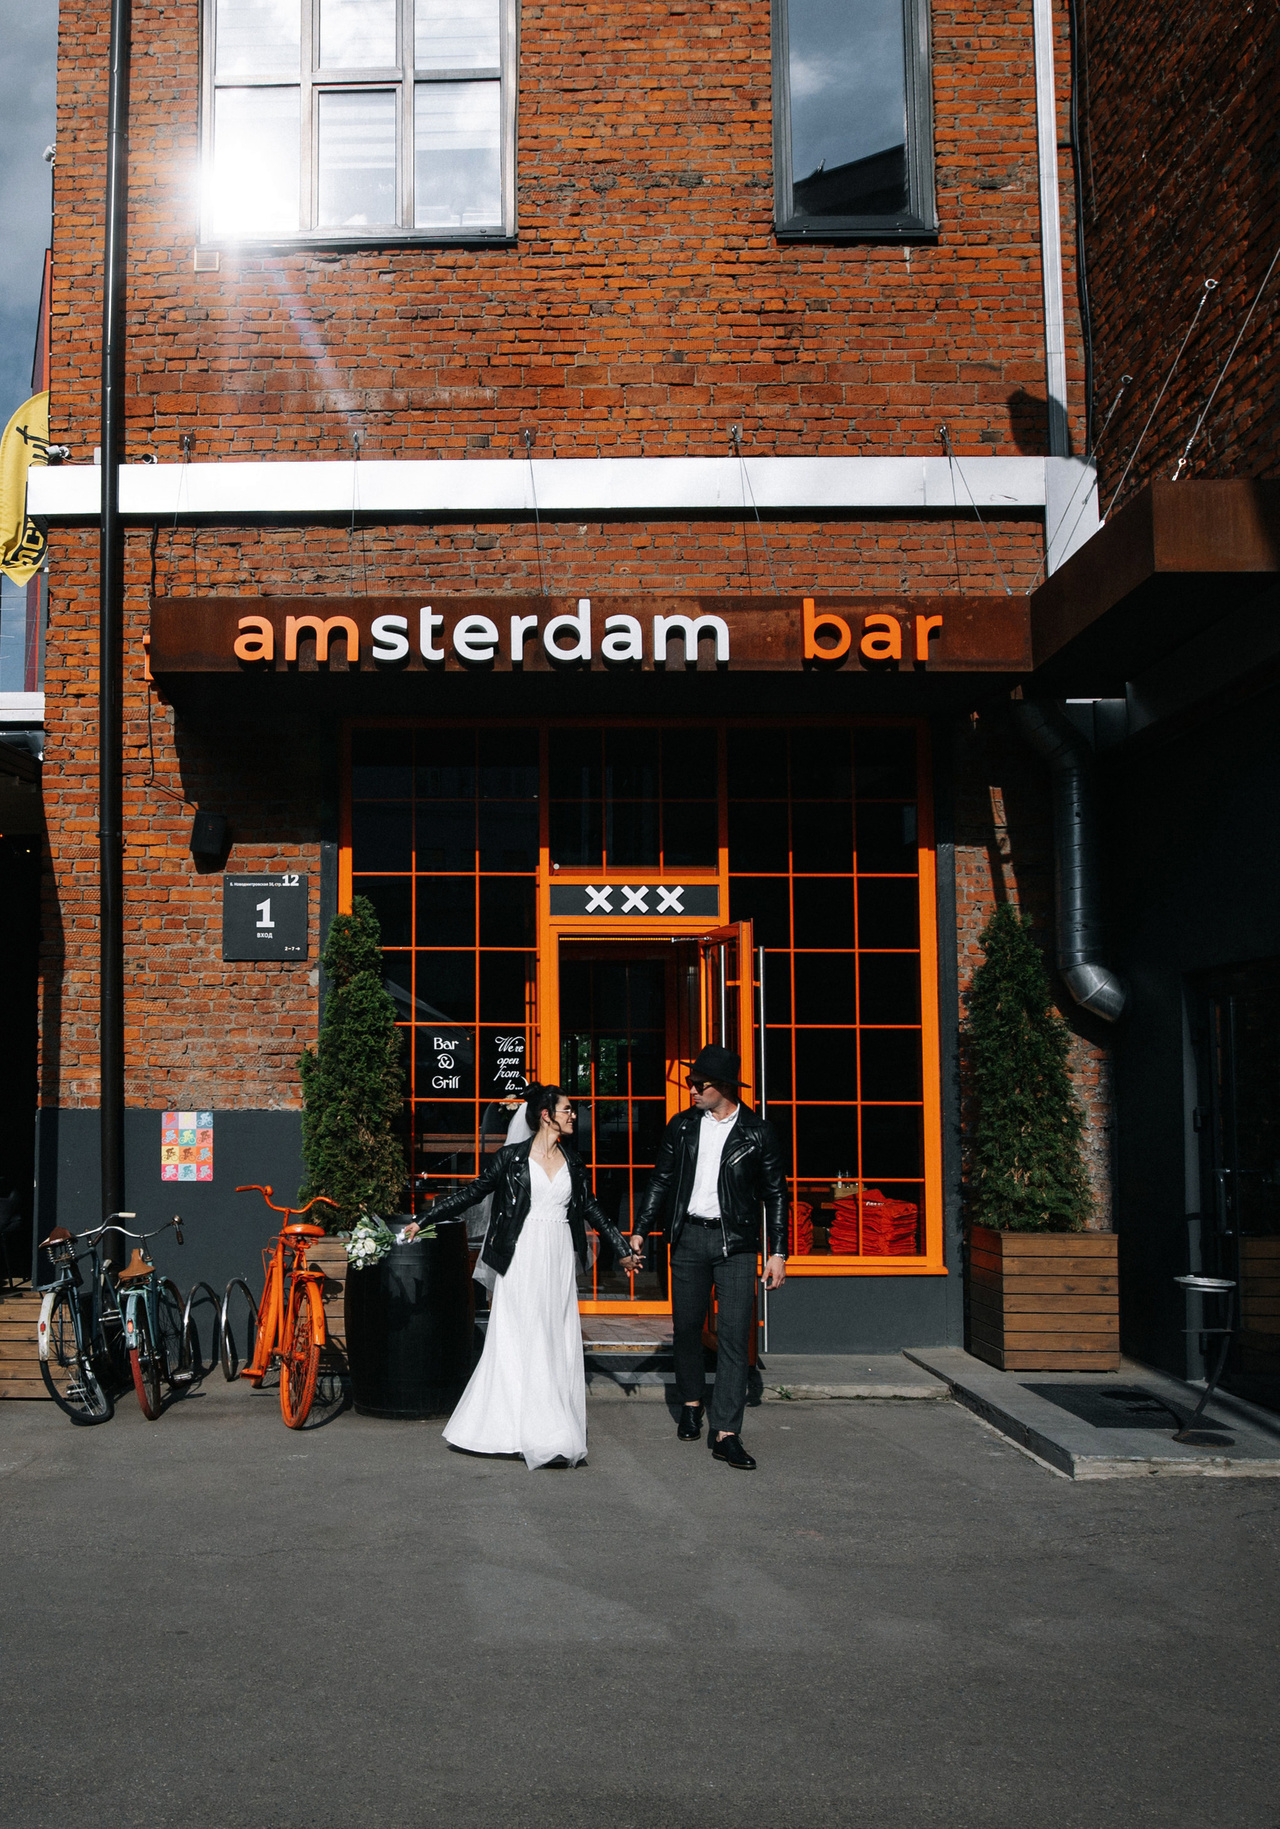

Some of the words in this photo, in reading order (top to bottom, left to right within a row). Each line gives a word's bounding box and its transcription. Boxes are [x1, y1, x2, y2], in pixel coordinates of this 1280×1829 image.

[233, 597, 730, 662] amsterdam
[802, 597, 943, 662] bar
[282, 874, 299, 886] 12
[256, 897, 275, 928] 1
[433, 1037, 459, 1050] Bar
[494, 1036, 526, 1053] We're
[436, 1053, 455, 1070] &
[496, 1057, 520, 1069] open
[493, 1065, 520, 1081] from
[431, 1075, 461, 1089] Grill
